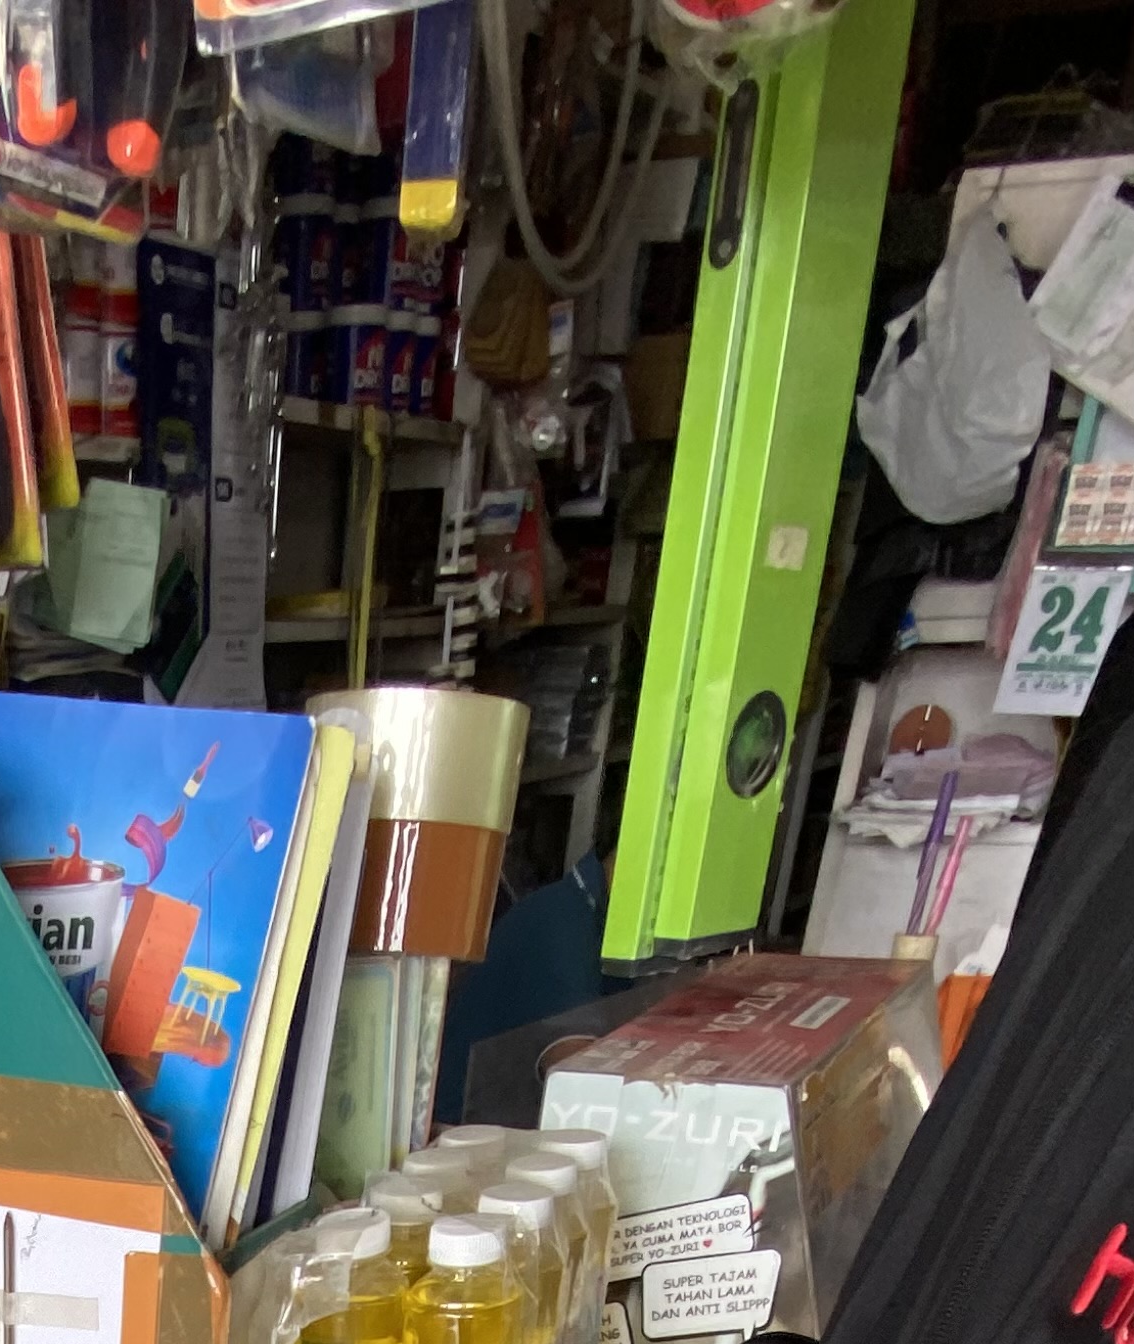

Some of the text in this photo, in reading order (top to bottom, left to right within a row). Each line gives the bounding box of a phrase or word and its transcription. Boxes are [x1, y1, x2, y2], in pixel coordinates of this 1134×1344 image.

[1029, 584, 1110, 654] 24
[624, 1219, 674, 1238] DENGAN
[677, 1203, 747, 1227] TEKNOLOGI
[641, 1233, 676, 1248] CUMA
[679, 1226, 714, 1241] MATA
[717, 1220, 743, 1233] BOR
[610, 1252, 644, 1268] SUPER
[663, 1267, 758, 1290] SUPER TAJAM
[664, 1284, 755, 1304] TAHAN LAMA
[651, 1297, 771, 1322] DAN ANTI SLIPPP
